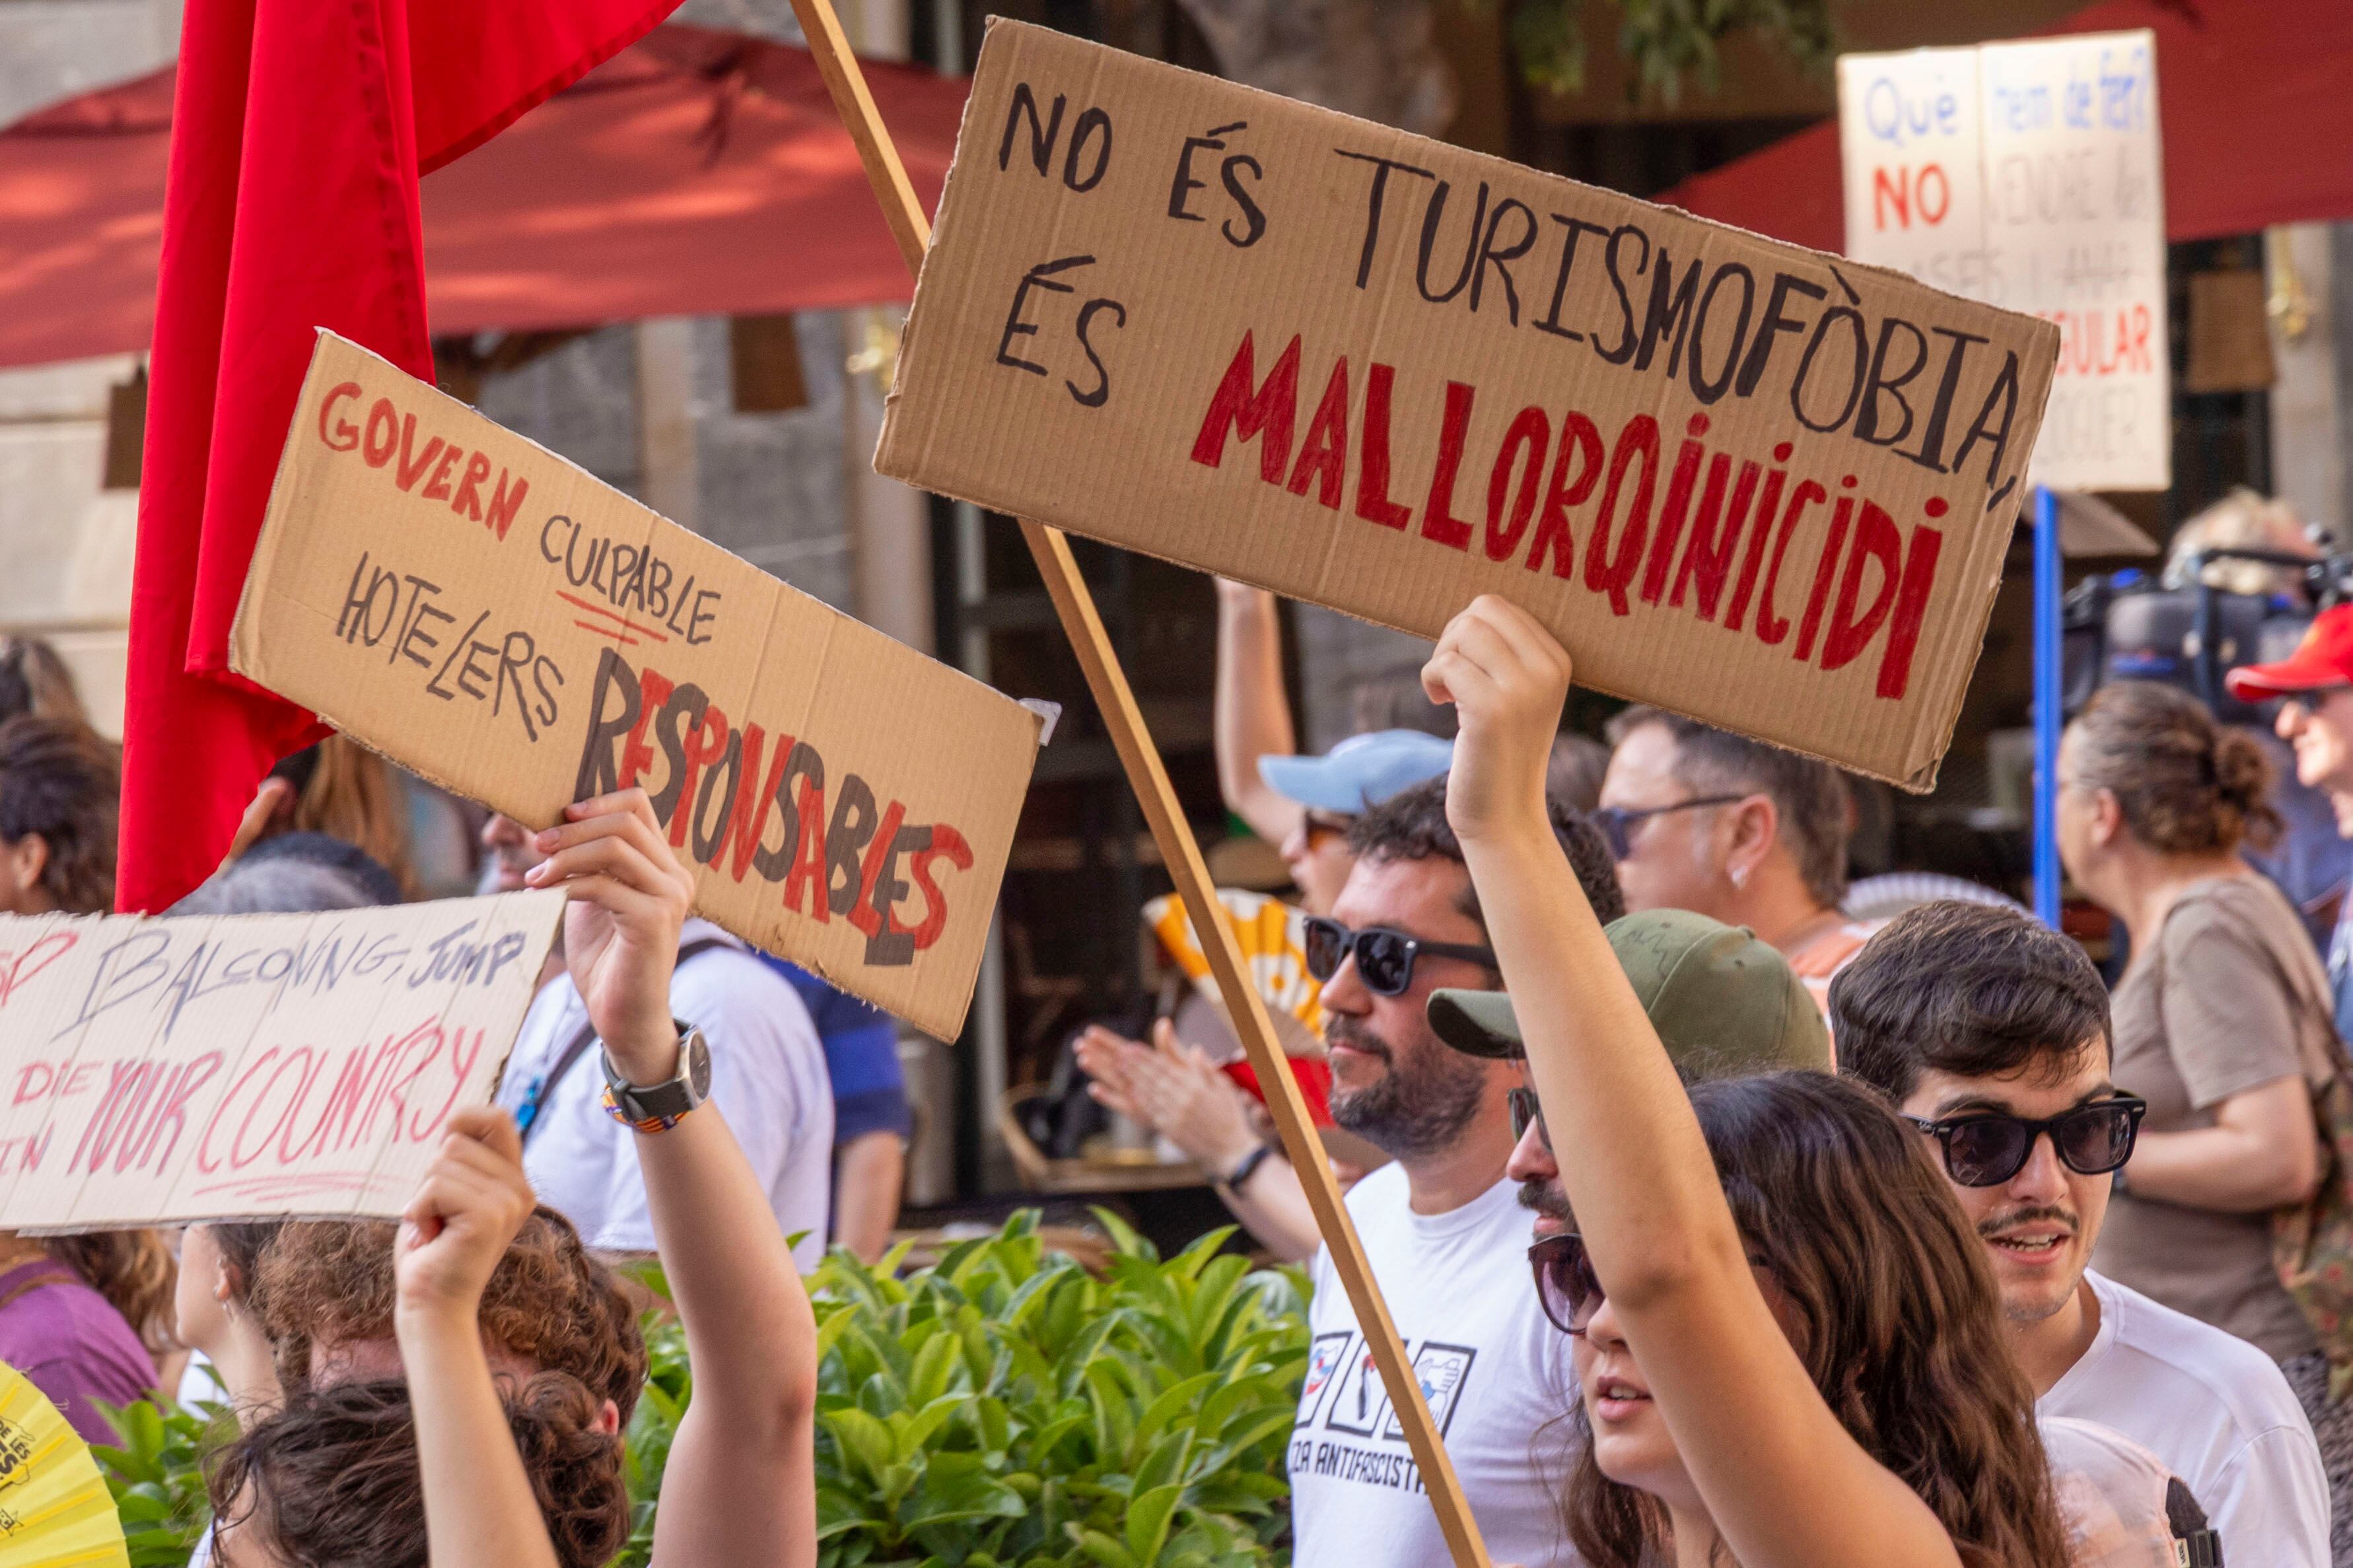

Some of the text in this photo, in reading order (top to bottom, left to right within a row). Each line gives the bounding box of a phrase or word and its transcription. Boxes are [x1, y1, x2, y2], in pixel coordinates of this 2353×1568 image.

[1872, 162, 1951, 232] NO
[996, 254, 1127, 408] ÉS
[999, 82, 1113, 193] NO
[1168, 121, 1267, 248] ÉS
[1333, 148, 2018, 512] TURISMOFÒBIA,
[2037, 302, 2152, 376] GULAR
[318, 382, 722, 645] GOVERN CULPABLE
[335, 551, 565, 743] HOTELERS
[573, 646, 974, 966] RESPONSABLES
[406, 918, 526, 989] JUMP
[67, 1049, 225, 1178] YOUR
[197, 1013, 485, 1175] COUNTRY
[9, 1437, 31, 1460] LES
